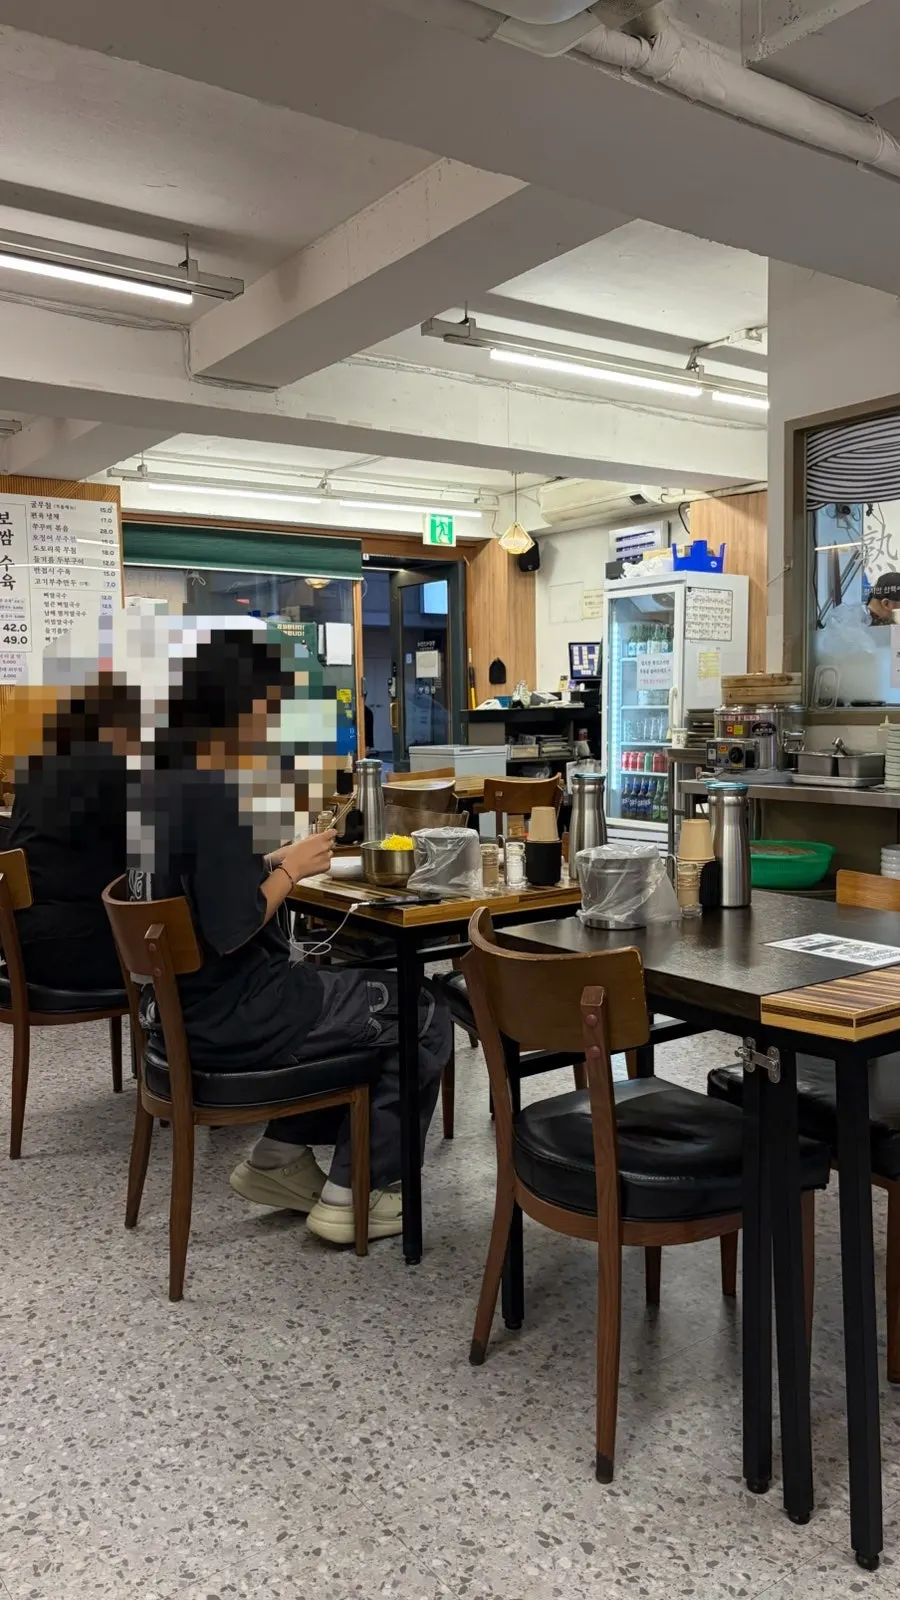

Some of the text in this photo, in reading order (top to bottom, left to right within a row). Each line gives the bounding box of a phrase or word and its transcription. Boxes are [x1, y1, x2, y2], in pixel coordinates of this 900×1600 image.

[32, 534, 53, 542] 오징어
[33, 545, 77, 554] 도토리묵 무침
[33, 556, 84, 565] 들기름 두부구이
[33, 567, 71, 576] 반접시 수육
[34, 578, 77, 586] 고기부추만두
[2, 623, 28, 633] 42.0
[3, 635, 28, 645] 49.0
